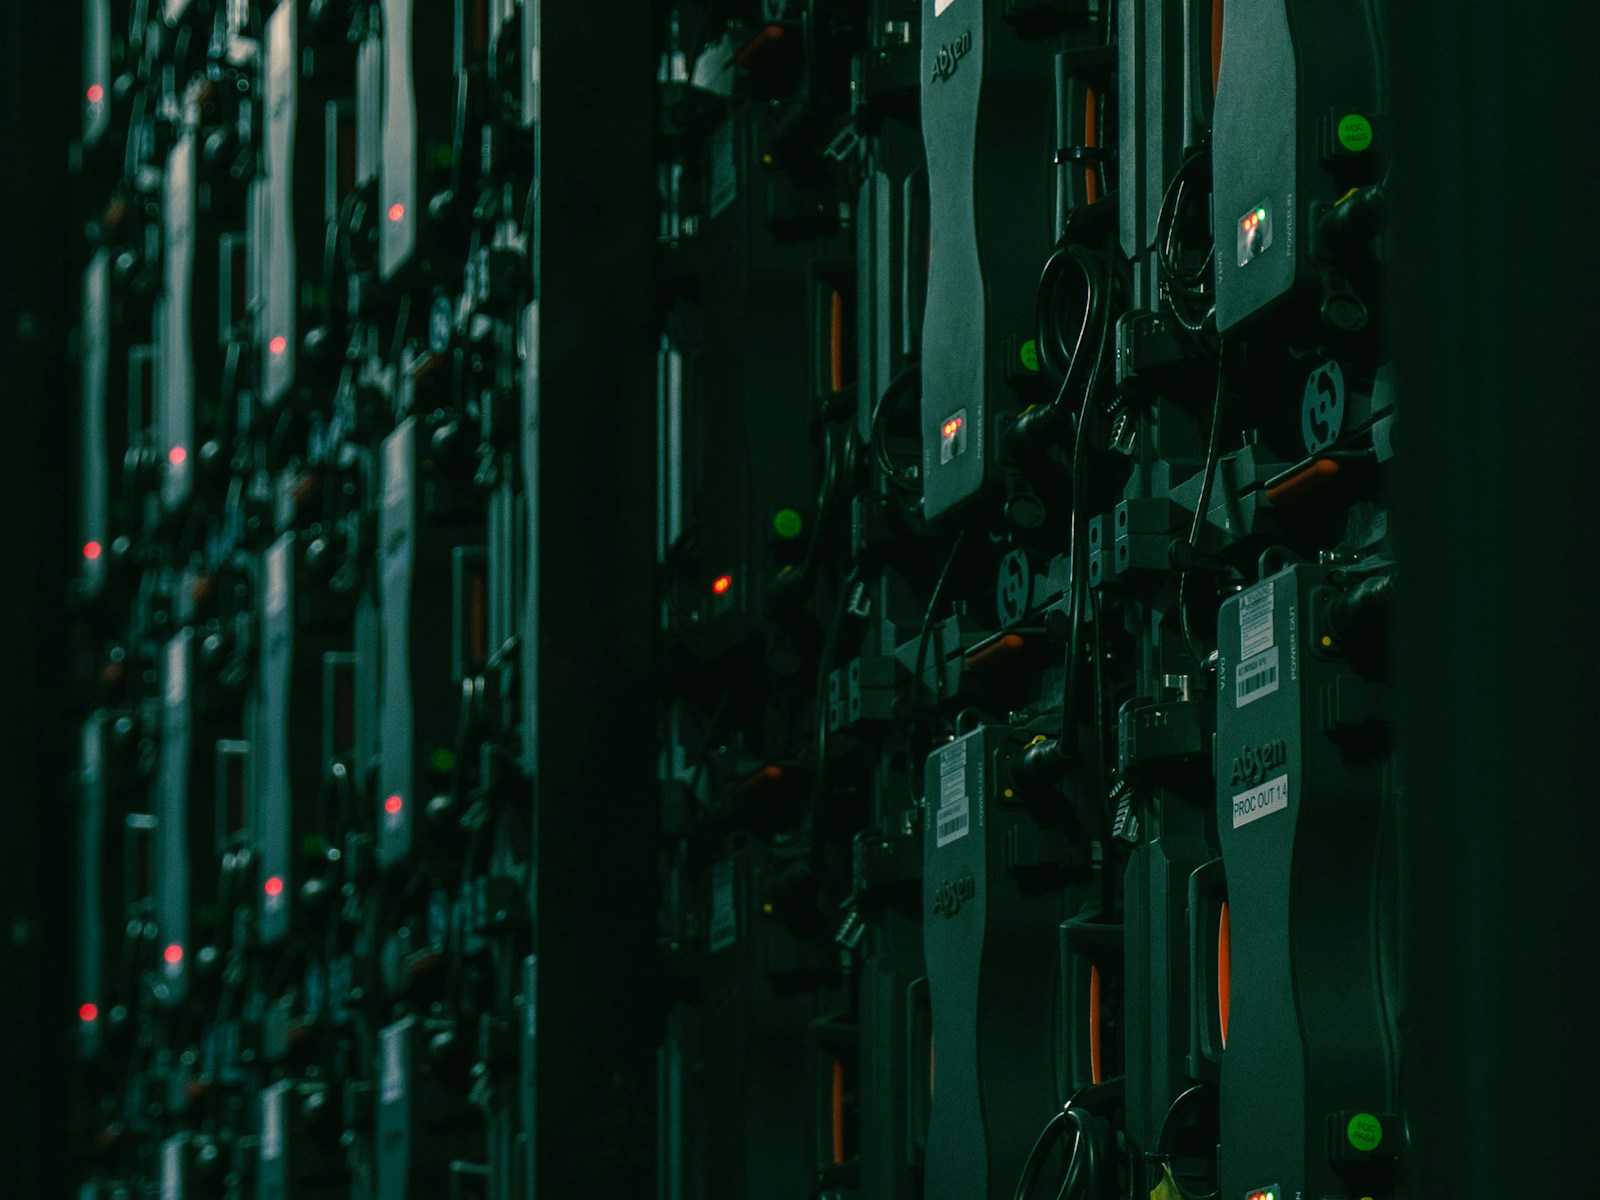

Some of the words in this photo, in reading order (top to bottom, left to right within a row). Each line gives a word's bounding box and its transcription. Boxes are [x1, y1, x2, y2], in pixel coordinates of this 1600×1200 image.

[931, 30, 972, 84] Absen
[1288, 605, 1296, 631] OUT
[1289, 633, 1297, 681] POWER
[1230, 739, 1287, 788] Absen
[1234, 796, 1256, 820] PROC
[1258, 788, 1275, 809] OUT
[1353, 1130, 1376, 1143] PASS
